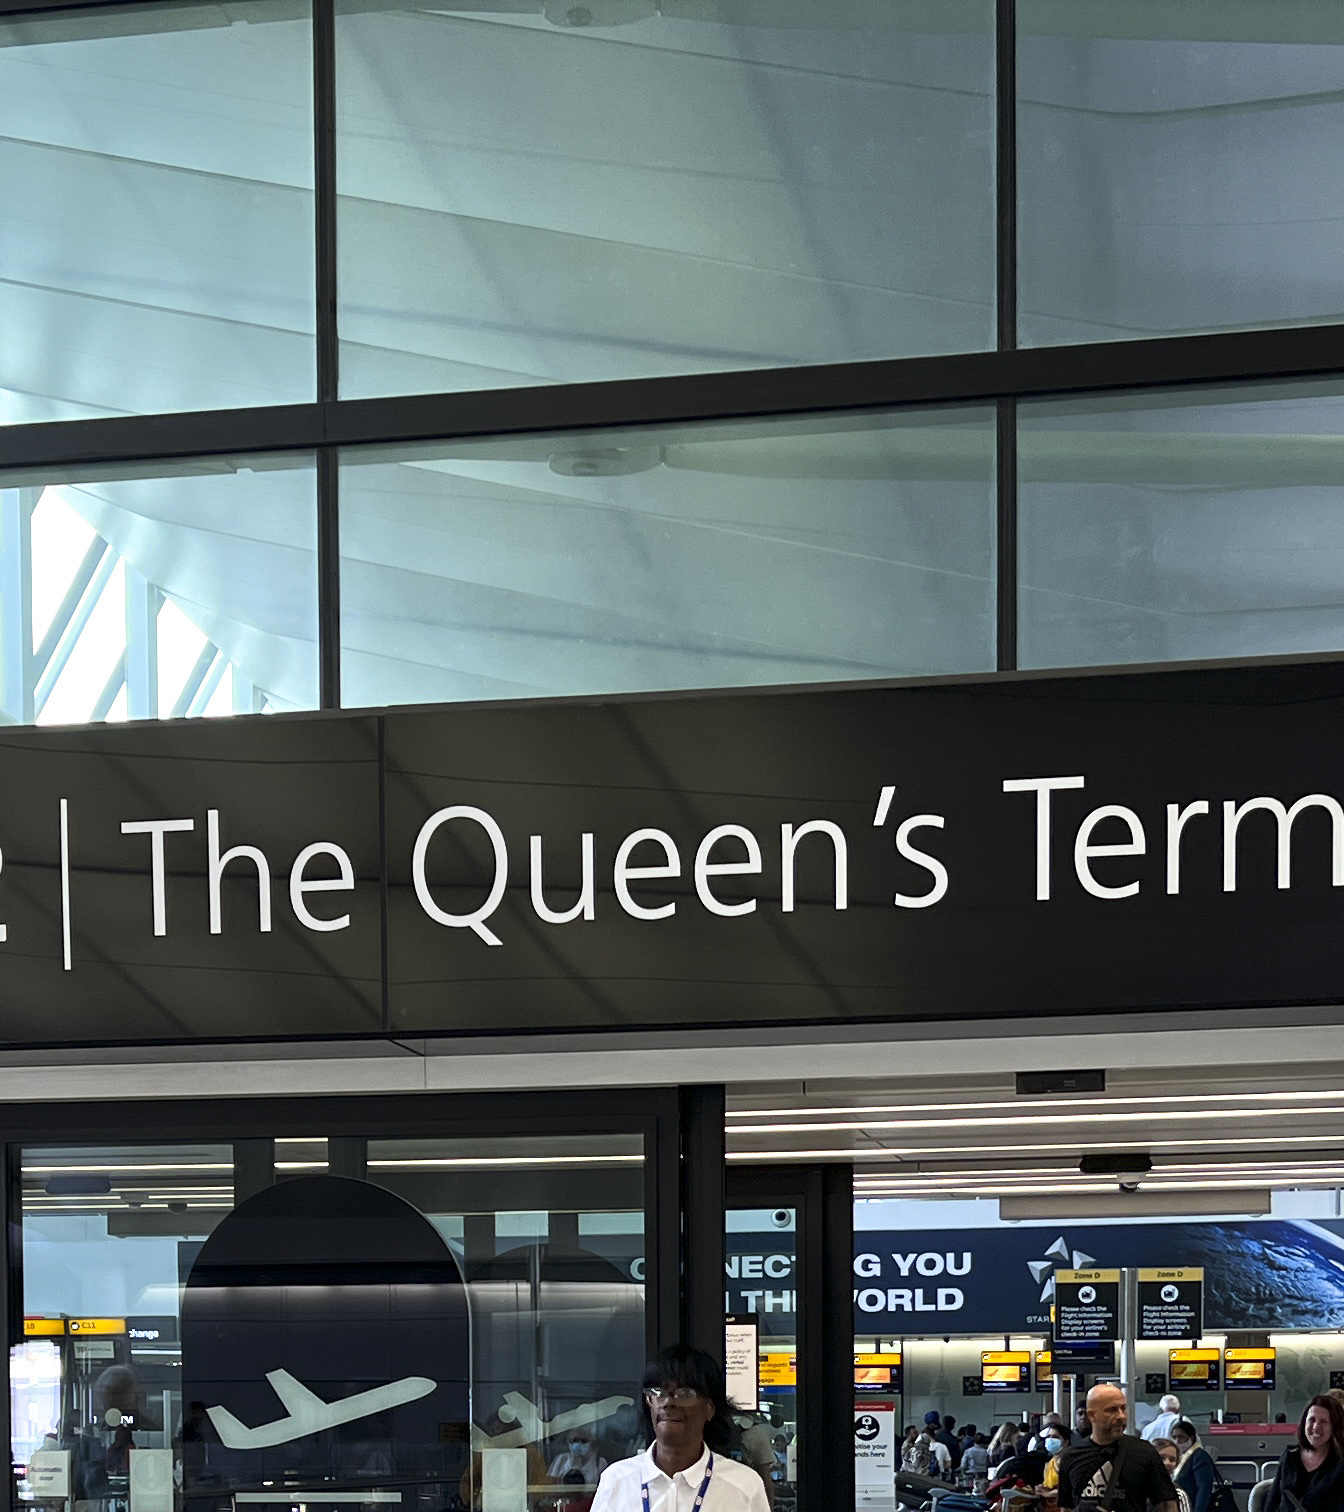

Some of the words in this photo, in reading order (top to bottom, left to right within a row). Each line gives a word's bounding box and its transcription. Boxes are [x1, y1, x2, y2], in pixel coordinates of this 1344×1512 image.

[121, 810, 354, 936] The
[413, 786, 948, 945] Queen’s
[892, 1252, 972, 1278] YOU
[853, 1287, 964, 1313] ORLD
[81, 1321, 96, 1329] C11
[128, 1328, 159, 1340] hange
